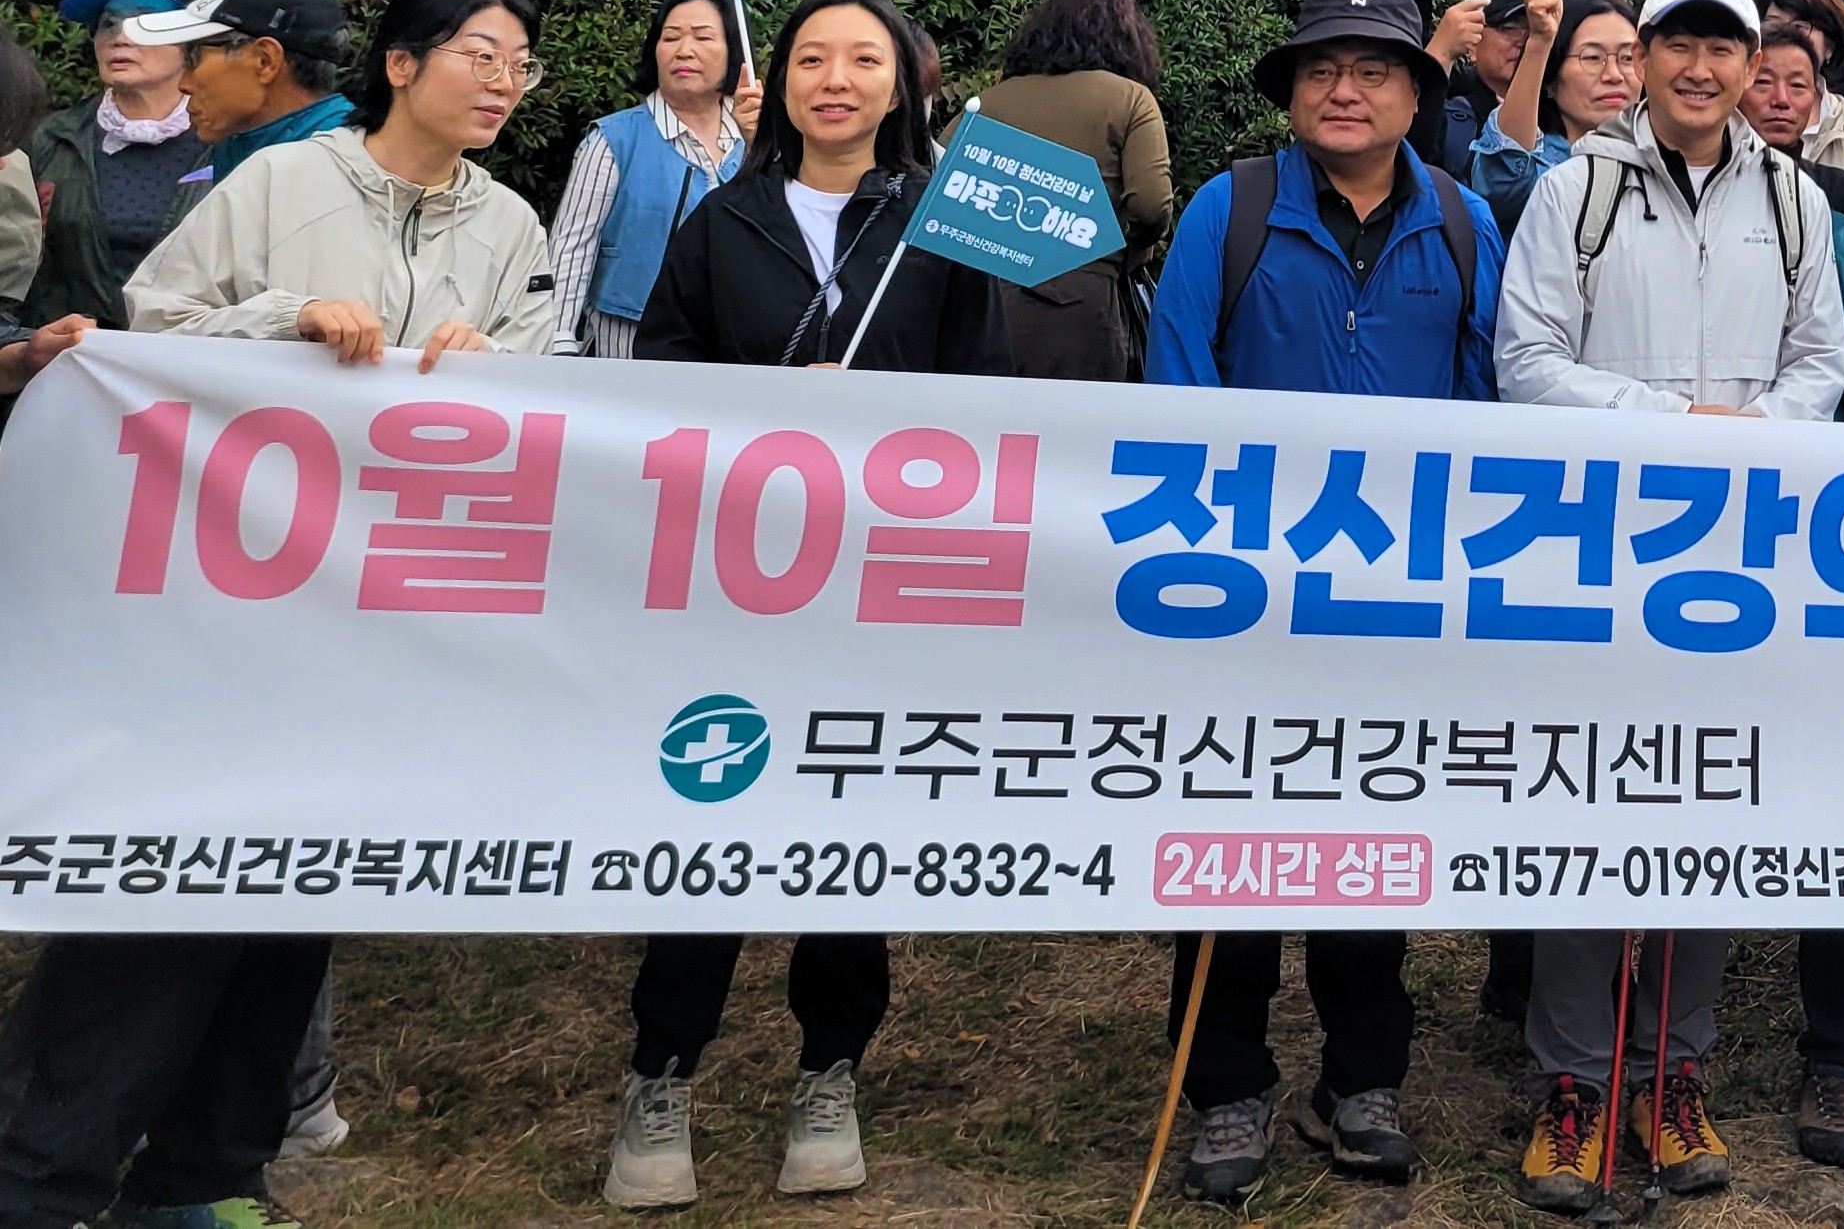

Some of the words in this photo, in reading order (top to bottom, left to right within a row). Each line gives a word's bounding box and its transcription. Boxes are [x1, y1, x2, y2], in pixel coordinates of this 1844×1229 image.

[963, 143, 993, 166] 10월
[992, 154, 1020, 176] 10일
[1019, 162, 1080, 198] 정신건강의
[1078, 186, 1094, 204] 날
[943, 170, 1003, 211] 마주
[1041, 204, 1097, 249] 해요
[939, 224, 1035, 267] 무주군정신건강복지센터
[114, 400, 566, 614] 10월
[643, 426, 1041, 627] 10일
[795, 709, 1763, 806] 무주군정신건강복지센터
[1161, 840, 1322, 897] 24시간
[1335, 842, 1425, 898] 상담
